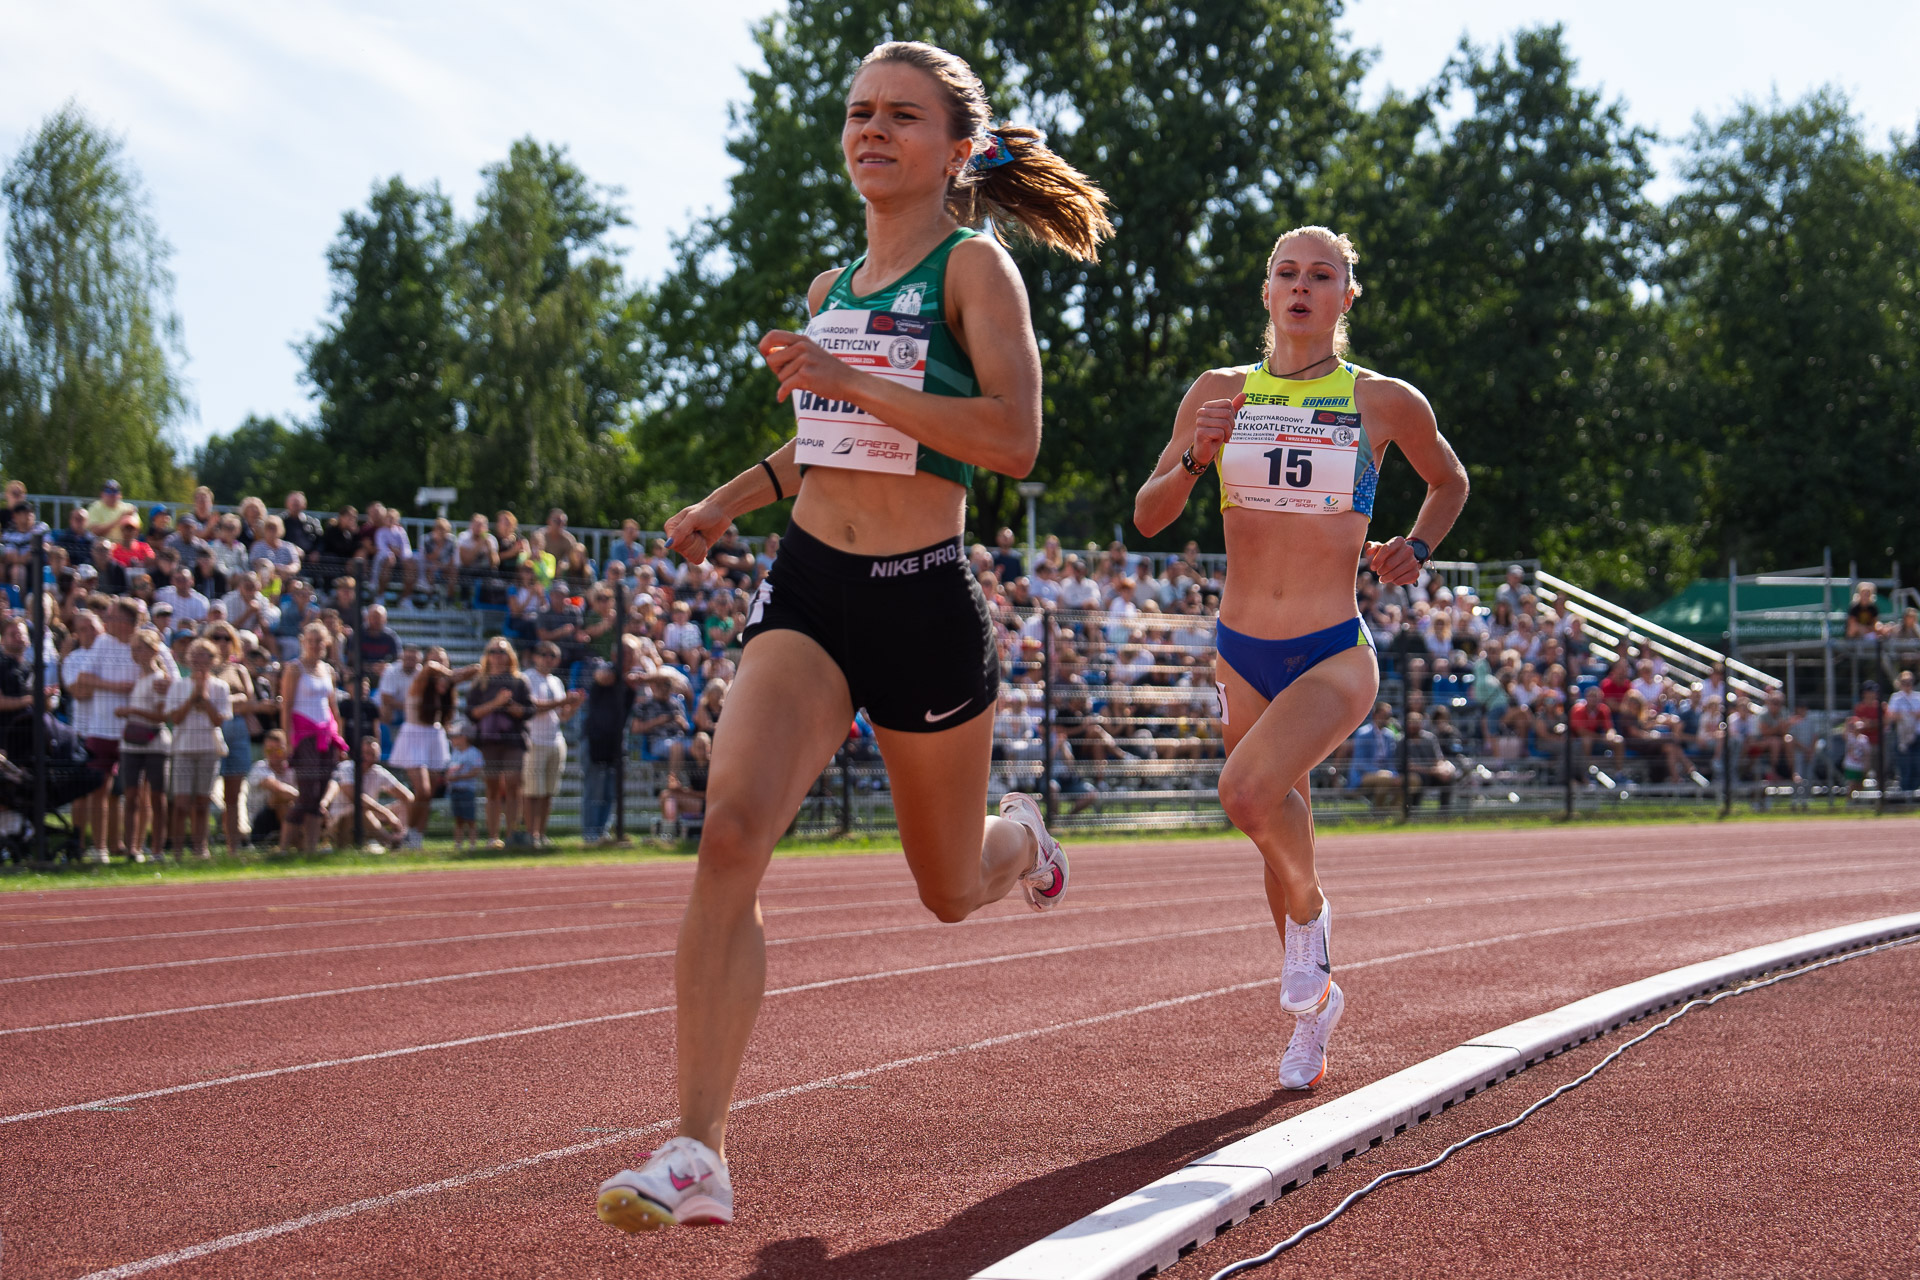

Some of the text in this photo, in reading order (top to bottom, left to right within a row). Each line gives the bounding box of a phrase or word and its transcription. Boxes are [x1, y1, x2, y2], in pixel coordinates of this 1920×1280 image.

[866, 449, 912, 461] SPORT
[1263, 447, 1313, 488] 15
[870, 544, 957, 577] NIKE PRO
